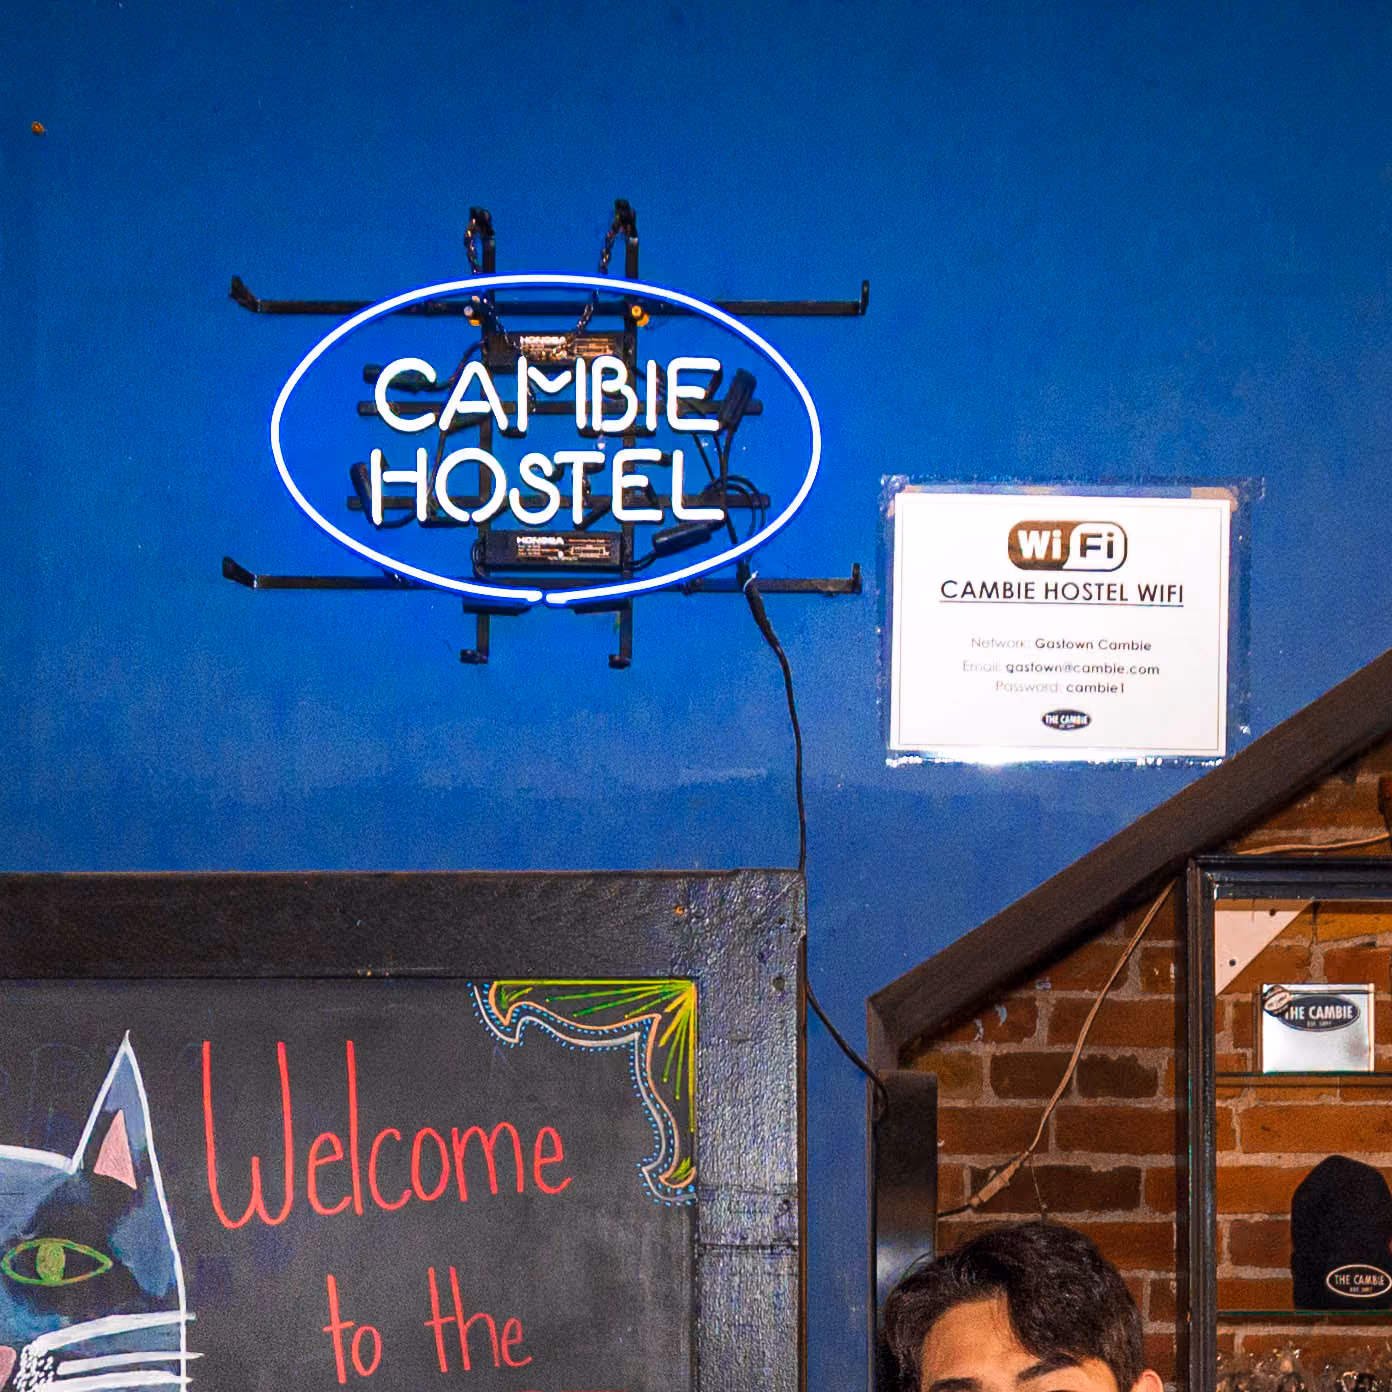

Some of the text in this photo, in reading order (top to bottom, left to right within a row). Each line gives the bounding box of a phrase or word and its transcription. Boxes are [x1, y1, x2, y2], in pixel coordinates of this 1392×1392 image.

[373, 355, 722, 433] CAMBIE
[370, 447, 725, 526] HOSTEL
[940, 580, 1184, 603] CAMBIE HOSTEL WIFI
[1035, 638, 1094, 650] Gastown
[1099, 639, 1152, 651] Cambie
[1005, 662, 1161, 675] gastown@cambie.com
[1066, 682, 1125, 694] cambie1
[1309, 1004, 1354, 1020] CAMBIE
[202, 1040, 574, 1229] Welcome
[1334, 1273, 1385, 1286] THE CAMBIE
[323, 1266, 534, 1384] to the
